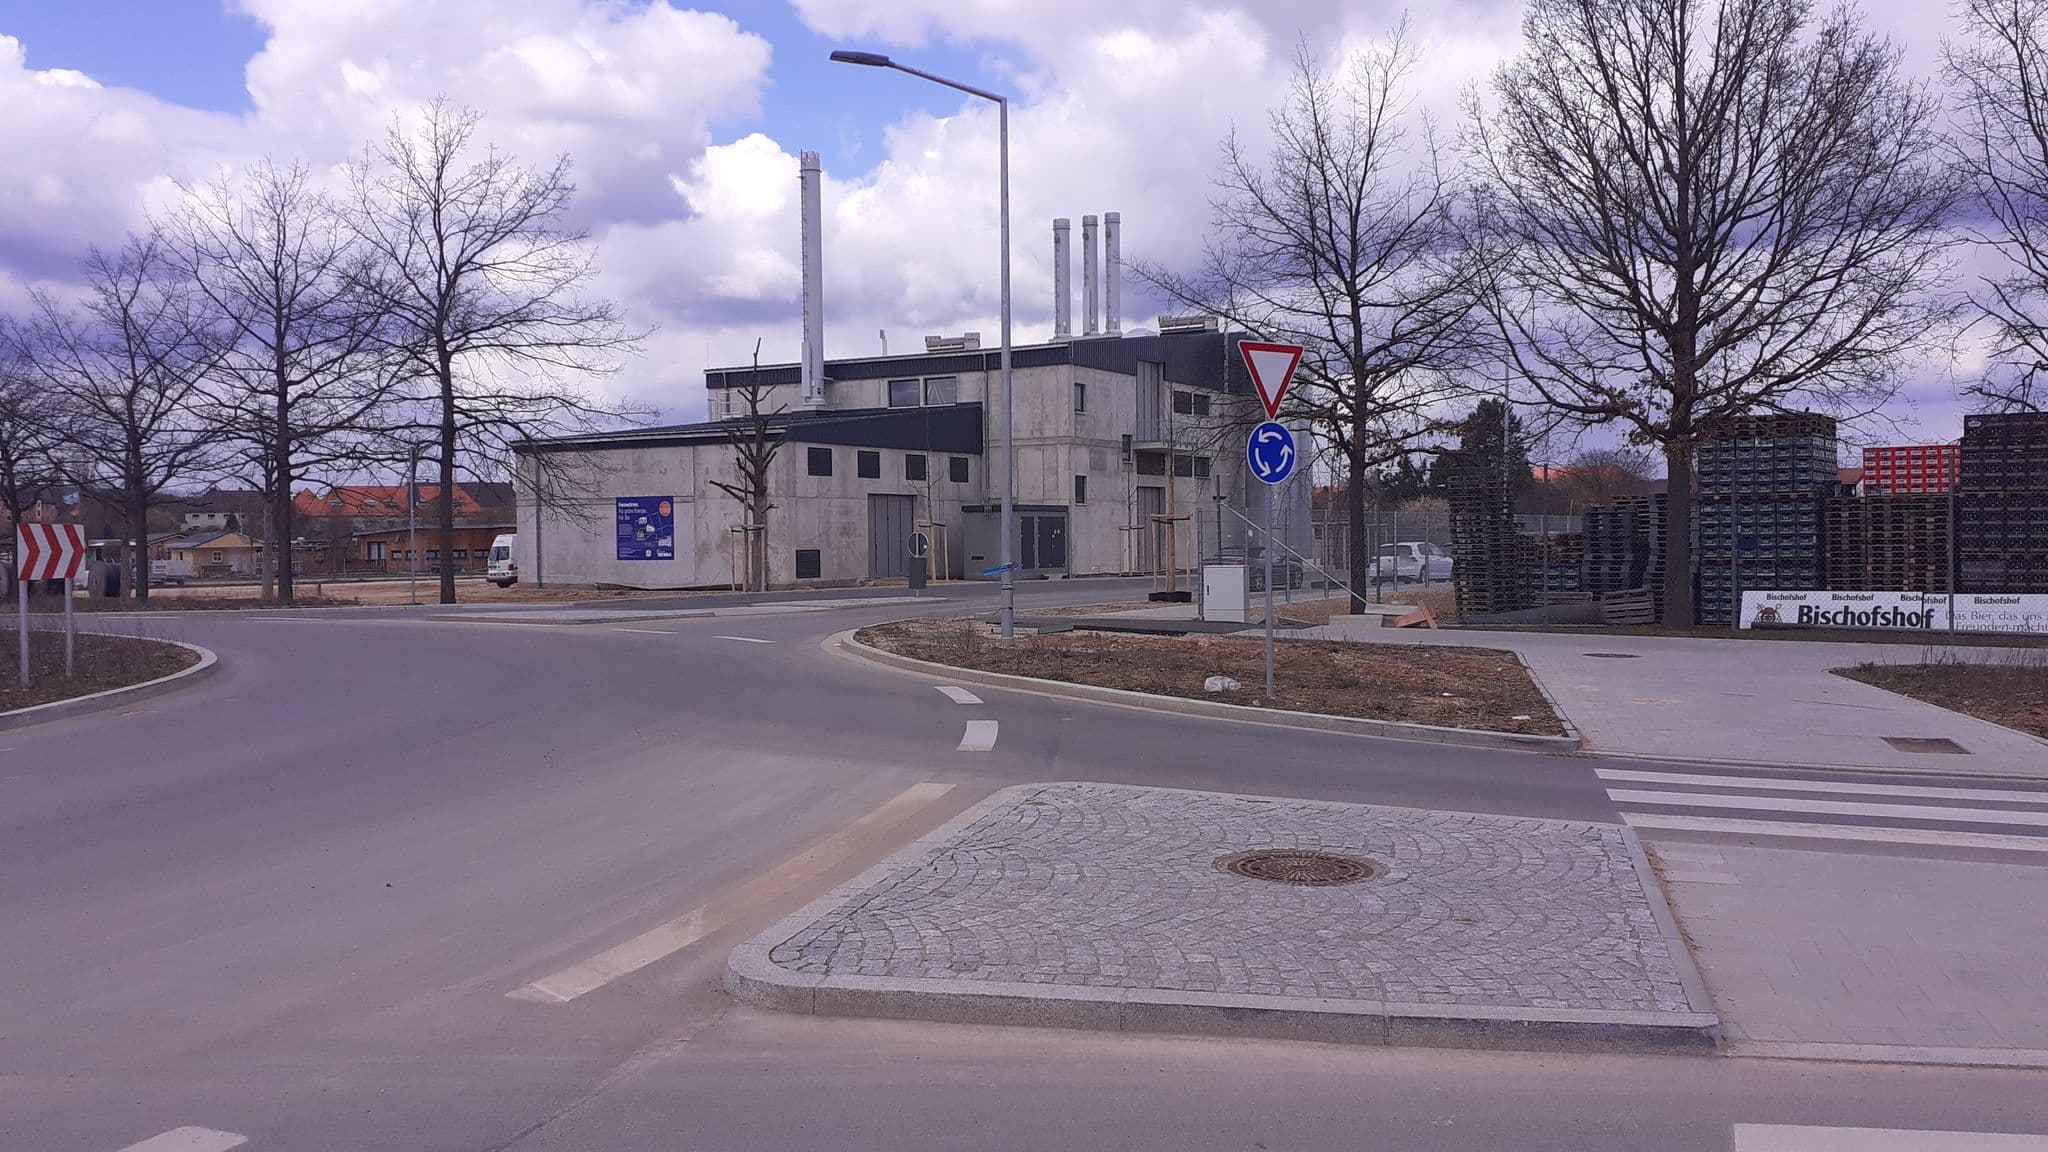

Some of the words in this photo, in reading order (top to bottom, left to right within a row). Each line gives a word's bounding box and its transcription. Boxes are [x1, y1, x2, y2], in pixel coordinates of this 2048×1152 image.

[1766, 593, 1807, 601] Bischofshof
[1831, 593, 1874, 601] Bischofshof
[1974, 596, 2021, 605] Bischofshof
[1798, 605, 1934, 629] Bischofshof
[1998, 610, 2018, 621] das
[2021, 612, 2042, 622] uns
